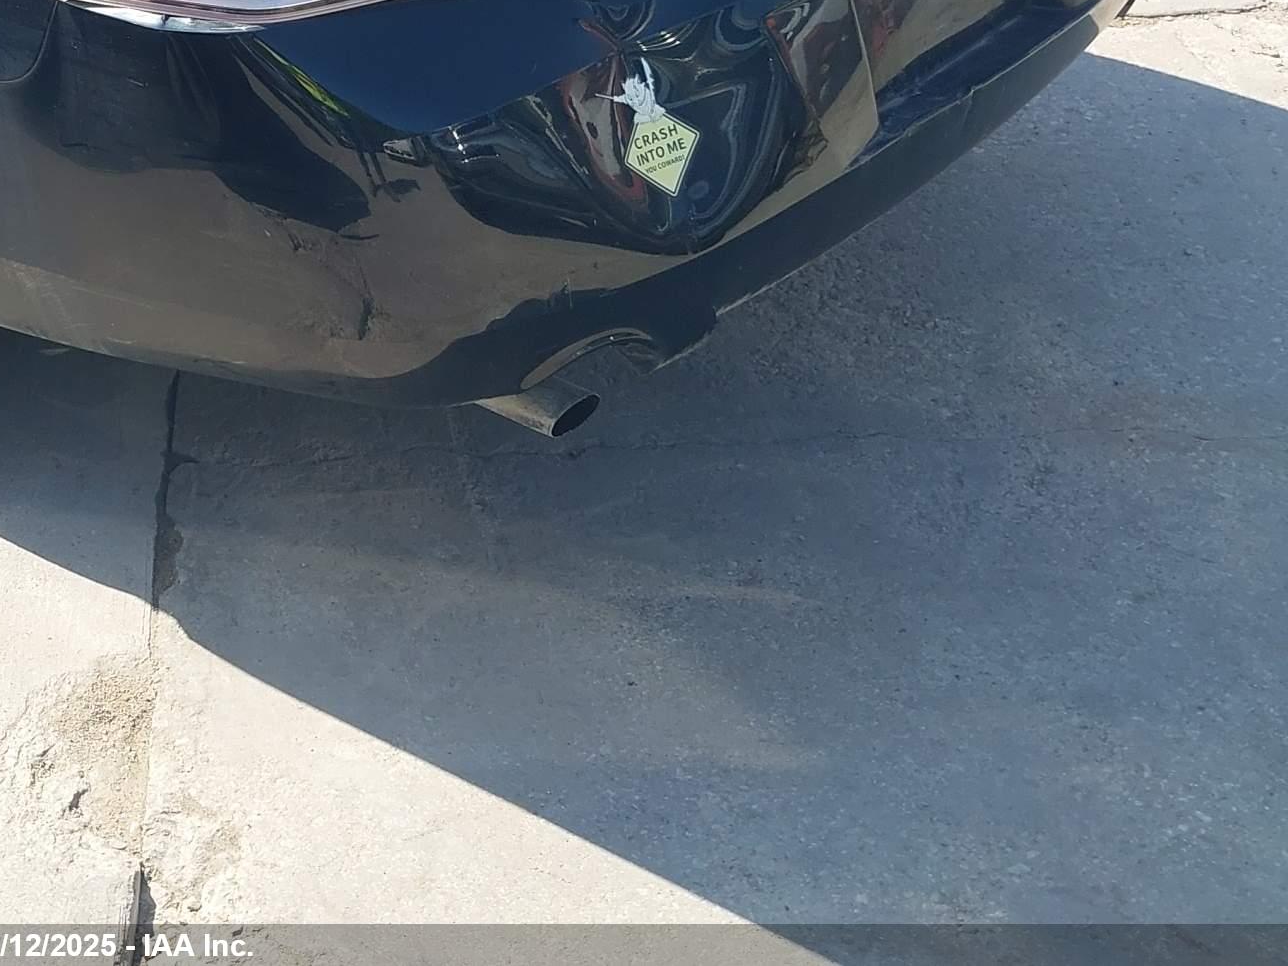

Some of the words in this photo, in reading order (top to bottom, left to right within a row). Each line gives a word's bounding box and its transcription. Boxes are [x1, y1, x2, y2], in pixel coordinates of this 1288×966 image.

[634, 124, 678, 149] CRASH
[636, 146, 665, 166] INTO
[666, 138, 687, 153] ME
[645, 164, 657, 174] YOU
